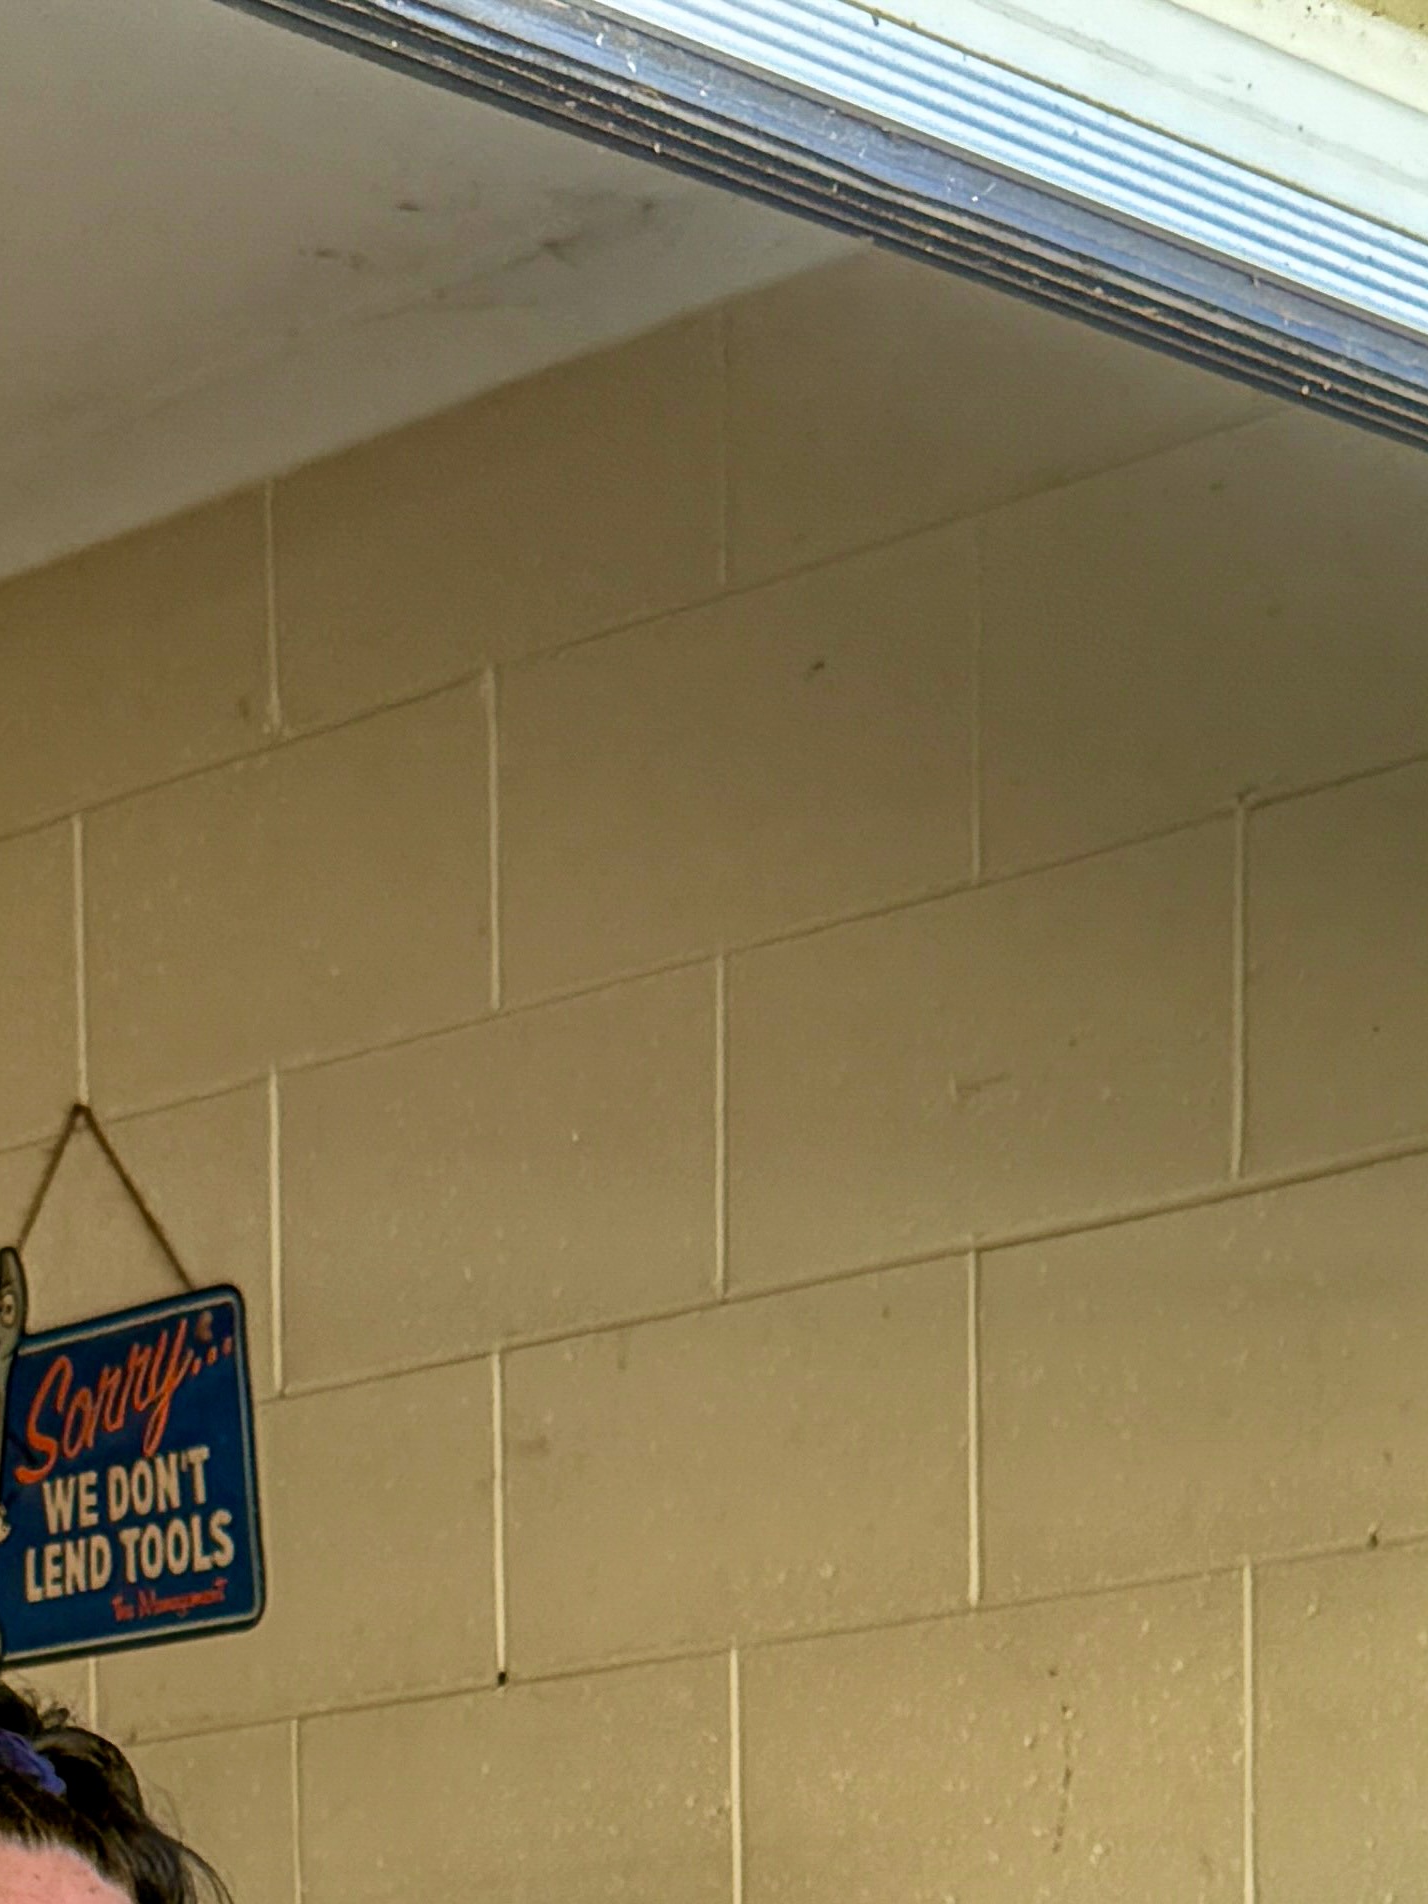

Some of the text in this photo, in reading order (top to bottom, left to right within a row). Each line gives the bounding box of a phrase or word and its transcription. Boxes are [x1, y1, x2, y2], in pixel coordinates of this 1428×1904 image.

[42, 1445, 211, 1535] WE DON'T
[25, 1508, 236, 1604] LEND TOOLS
